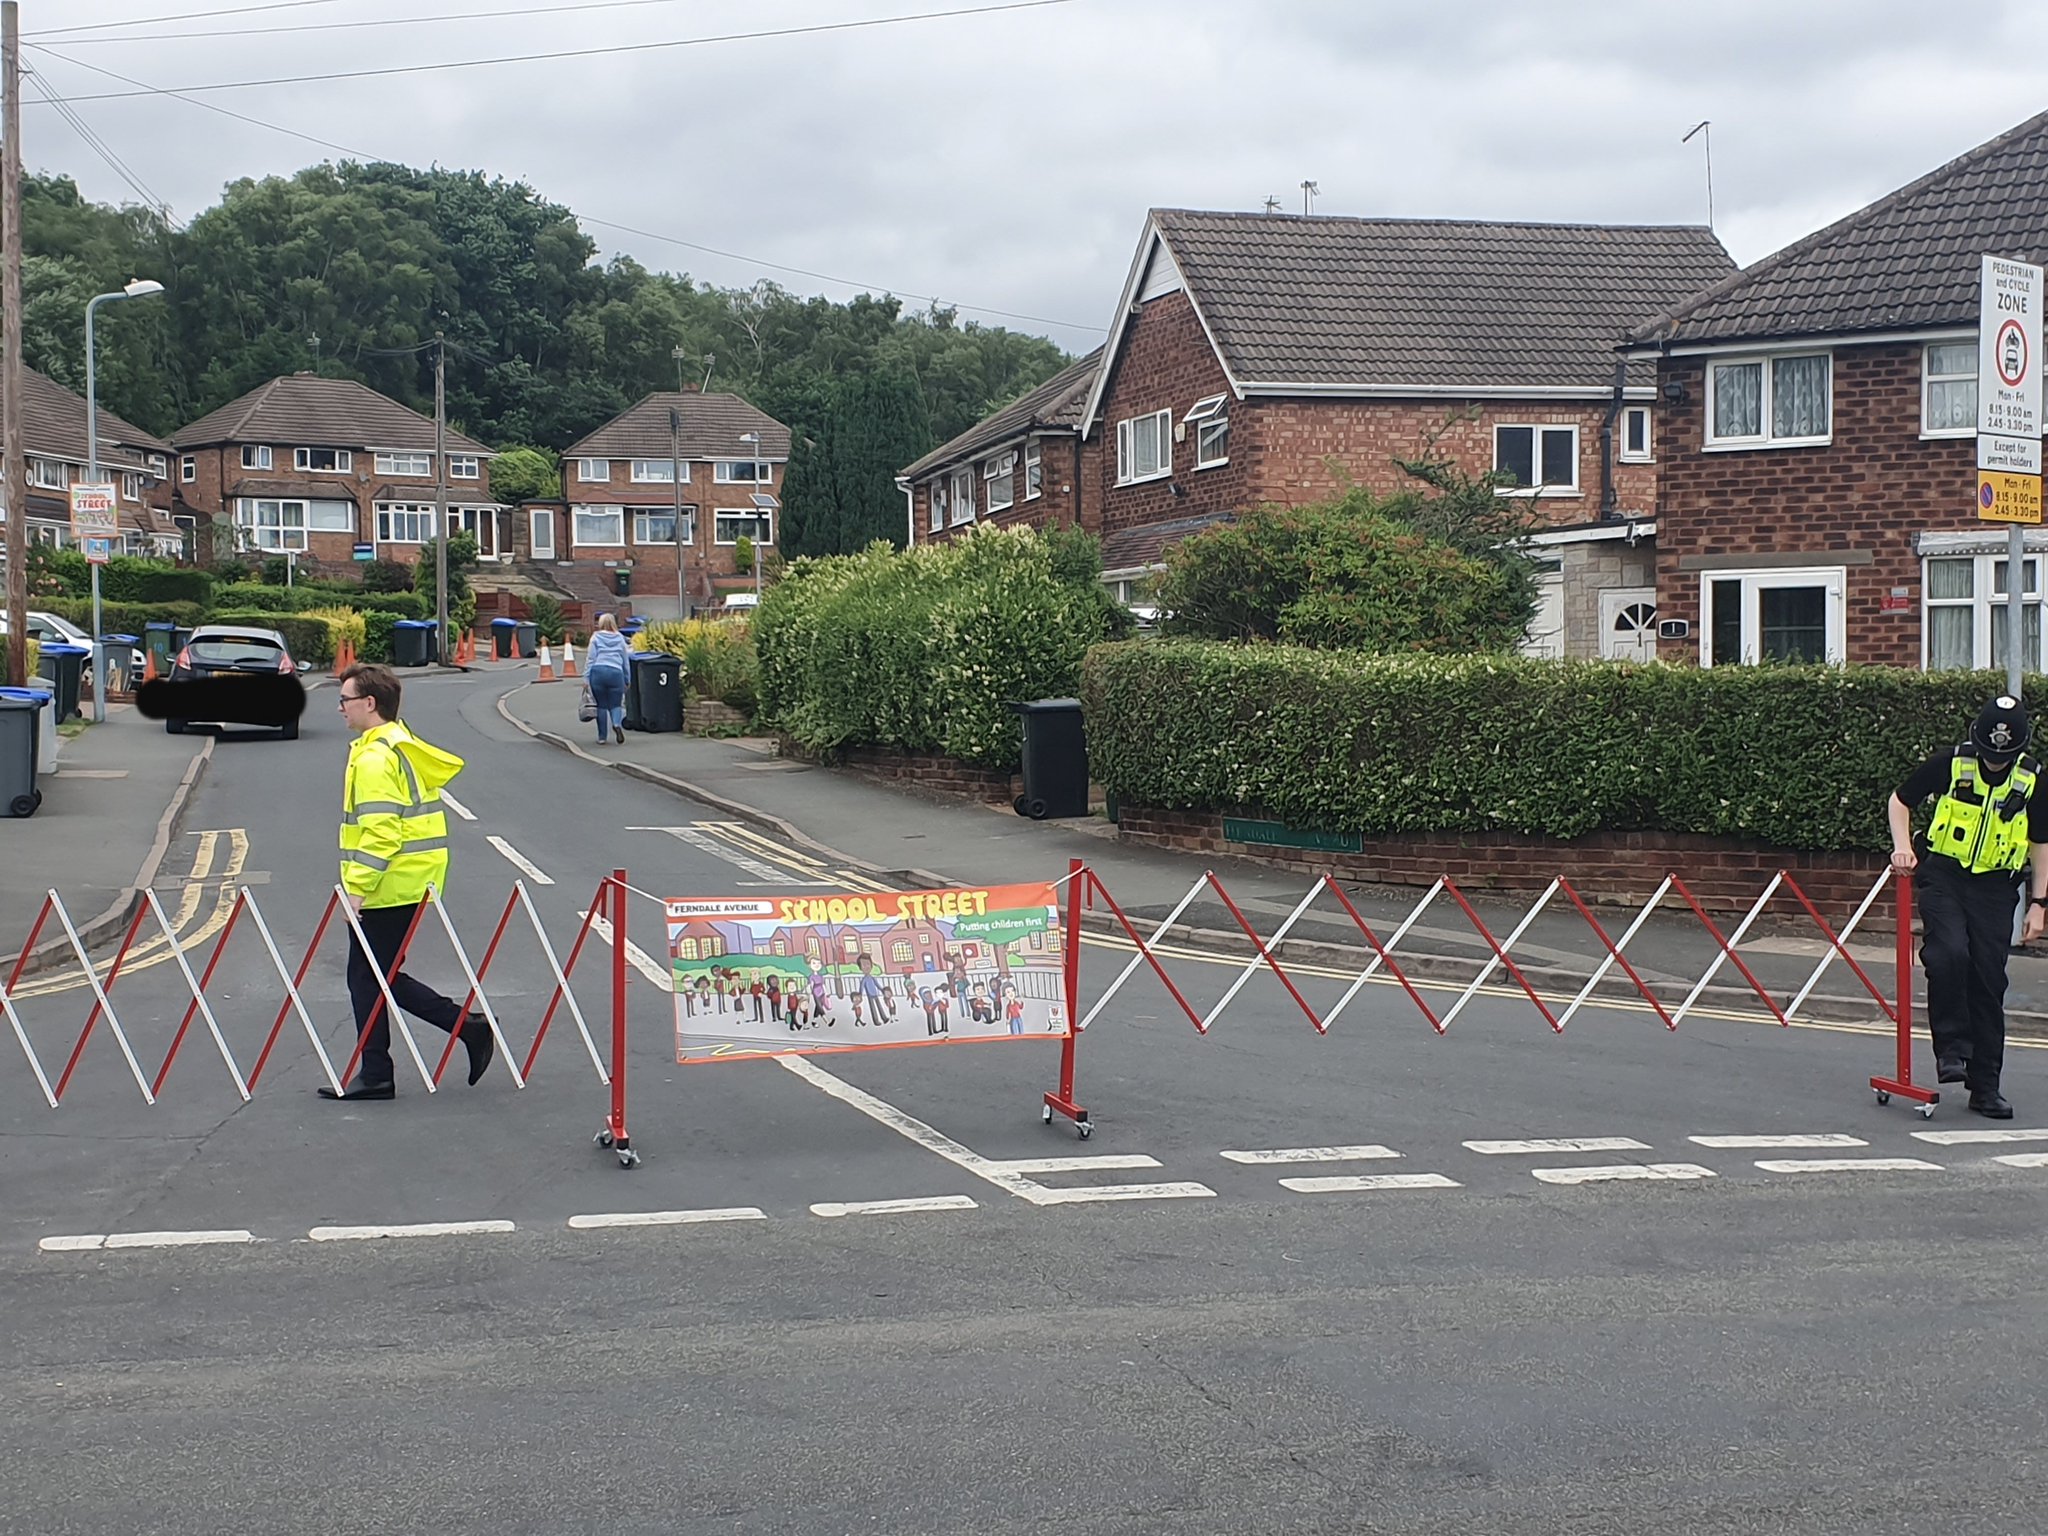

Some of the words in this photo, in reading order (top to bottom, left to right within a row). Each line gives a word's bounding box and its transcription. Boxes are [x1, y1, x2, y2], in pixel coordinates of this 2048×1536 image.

[1993, 261, 2034, 279] PEDESTRIAN
[1996, 278, 2008, 289] and
[2009, 279, 2030, 293] CYCLE
[1998, 292, 2027, 314] ZONE
[1998, 389, 2012, 400] Mon
[2016, 391, 2025, 402] Fri
[2006, 405, 2023, 418] 9.00
[2023, 410, 2033, 418] am
[1987, 416, 2003, 429] 2.45
[2007, 419, 2023, 431] 3.30
[2023, 423, 2034, 432] pm
[1994, 440, 2016, 453] Except
[2017, 443, 2027, 453] for
[1987, 455, 2009, 465] permit
[2009, 456, 2033, 468] holders
[2004, 477, 2018, 488] Mon
[2022, 479, 2031, 489] Fri
[77, 499, 112, 509] STREET
[2013, 492, 2029, 504] 9.00
[1995, 504, 2010, 516] 2.45
[2014, 506, 2029, 517] 3.30
[1637, 631, 1642, 648] 1
[659, 672, 668, 686] 3
[674, 904, 721, 914] FERNDALE
[724, 903, 760, 912] AVENUE
[779, 896, 888, 924] SCHOOL
[896, 890, 989, 921] STREET
[959, 922, 990, 932] Putting
[991, 919, 1025, 930] children
[1025, 917, 1043, 927] first
